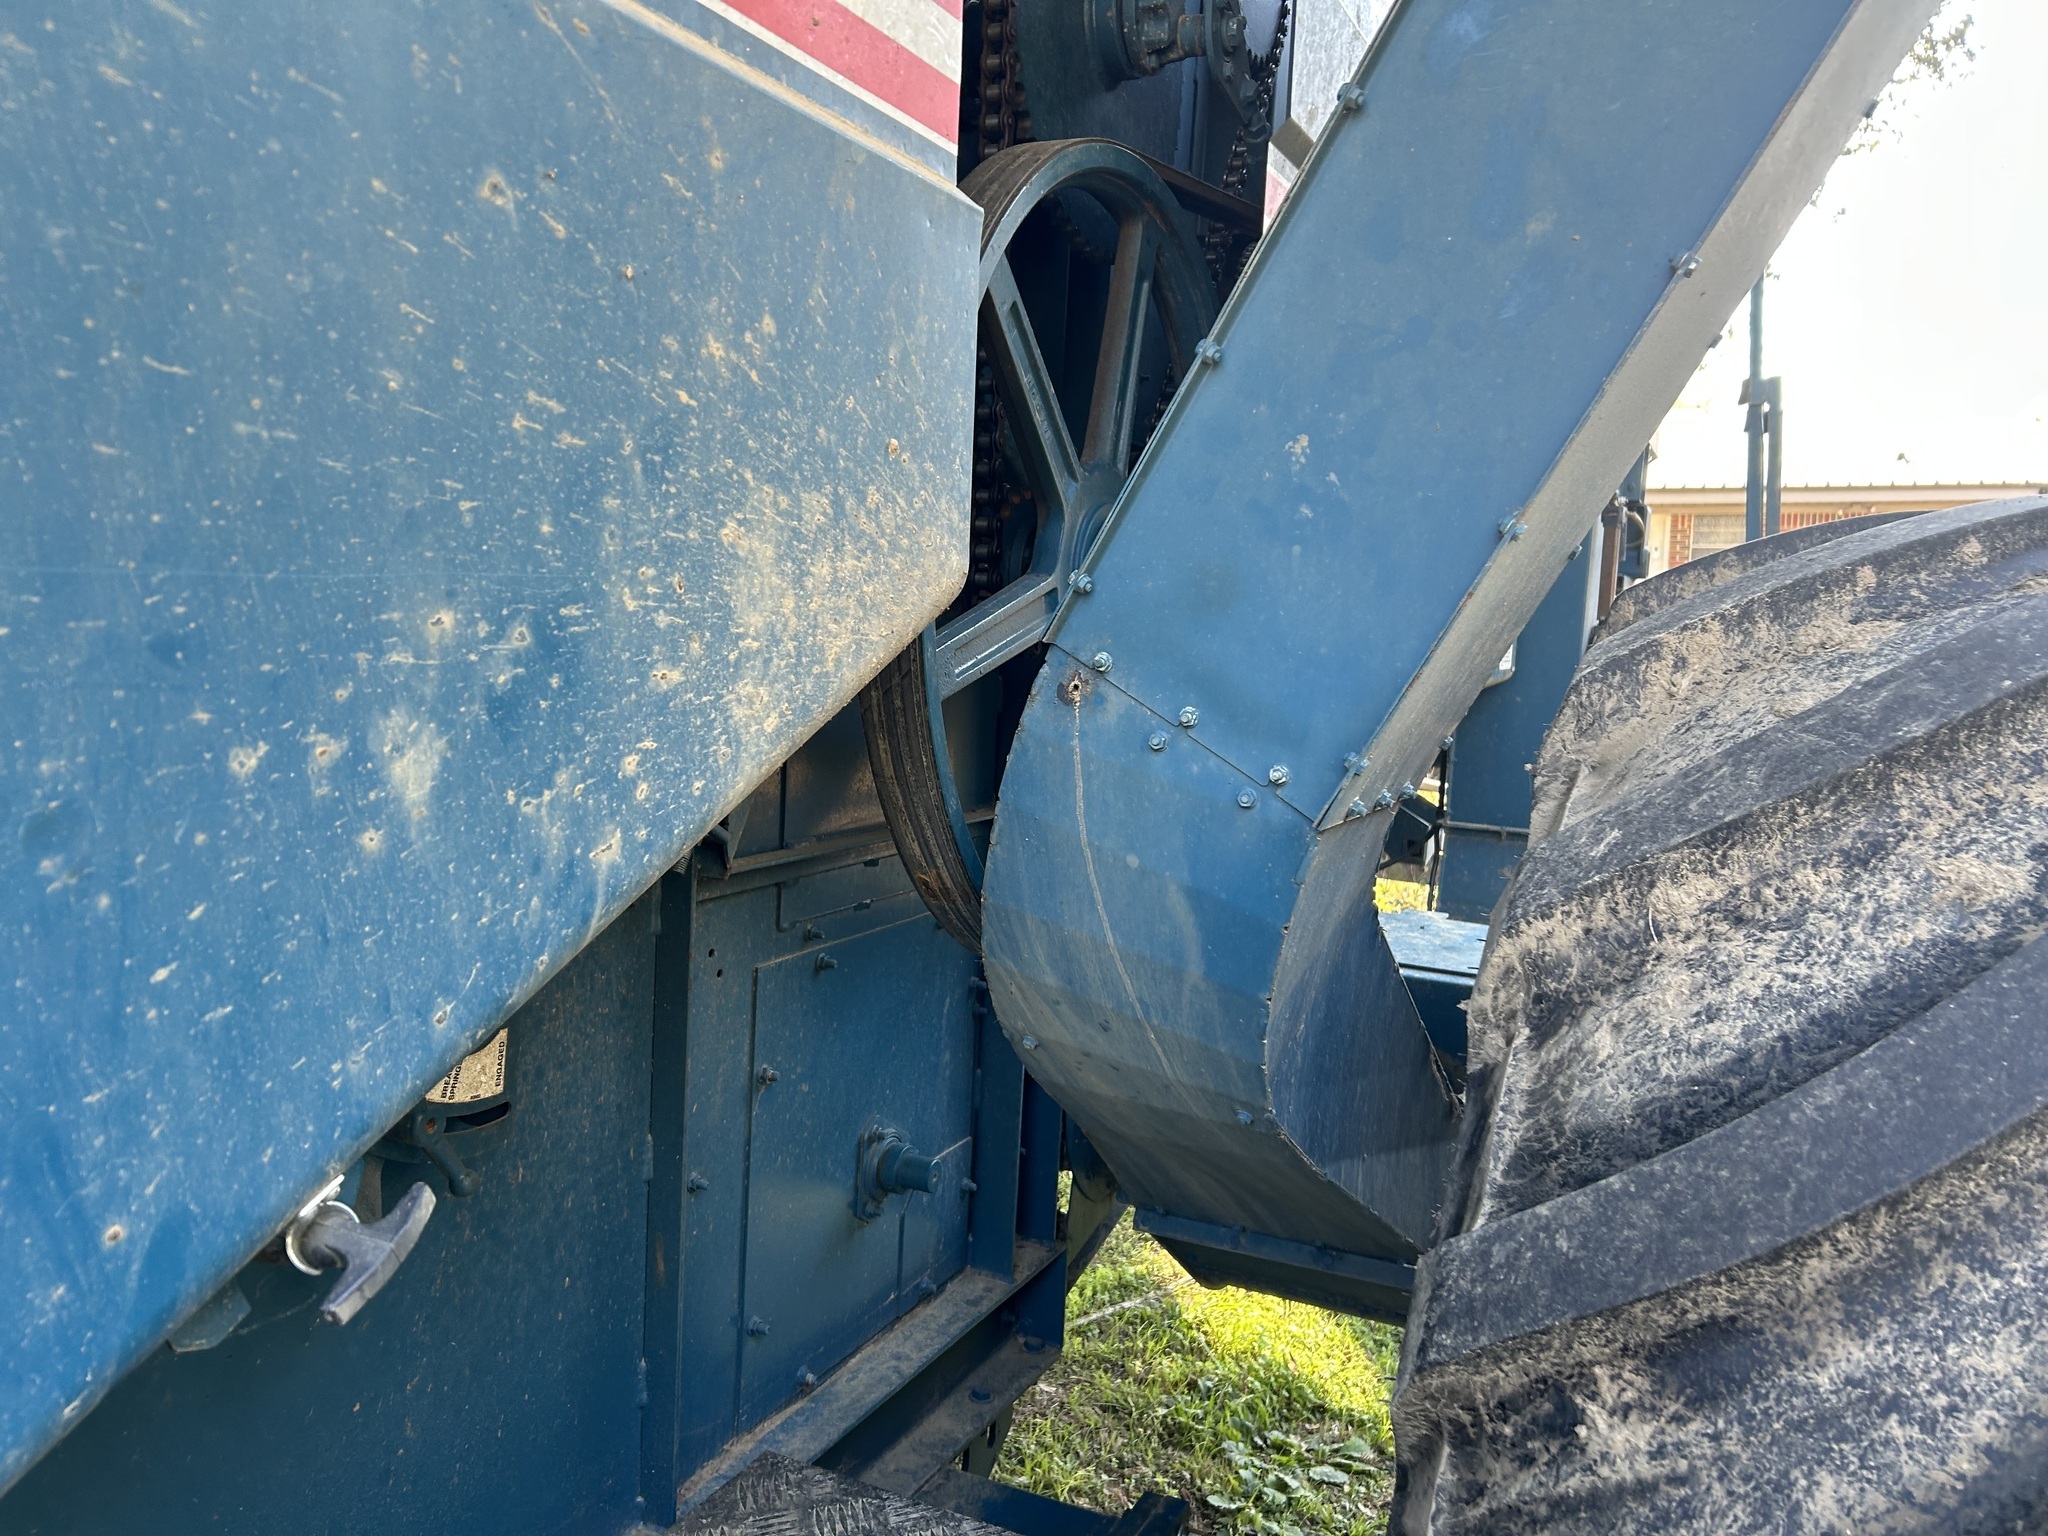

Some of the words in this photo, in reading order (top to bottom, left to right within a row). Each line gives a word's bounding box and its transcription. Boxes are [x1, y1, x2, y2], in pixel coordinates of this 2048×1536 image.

[495, 1041, 505, 1087] ENGAGED
[440, 1071, 453, 1099] BREA
[448, 1065, 462, 1101] SPRING
